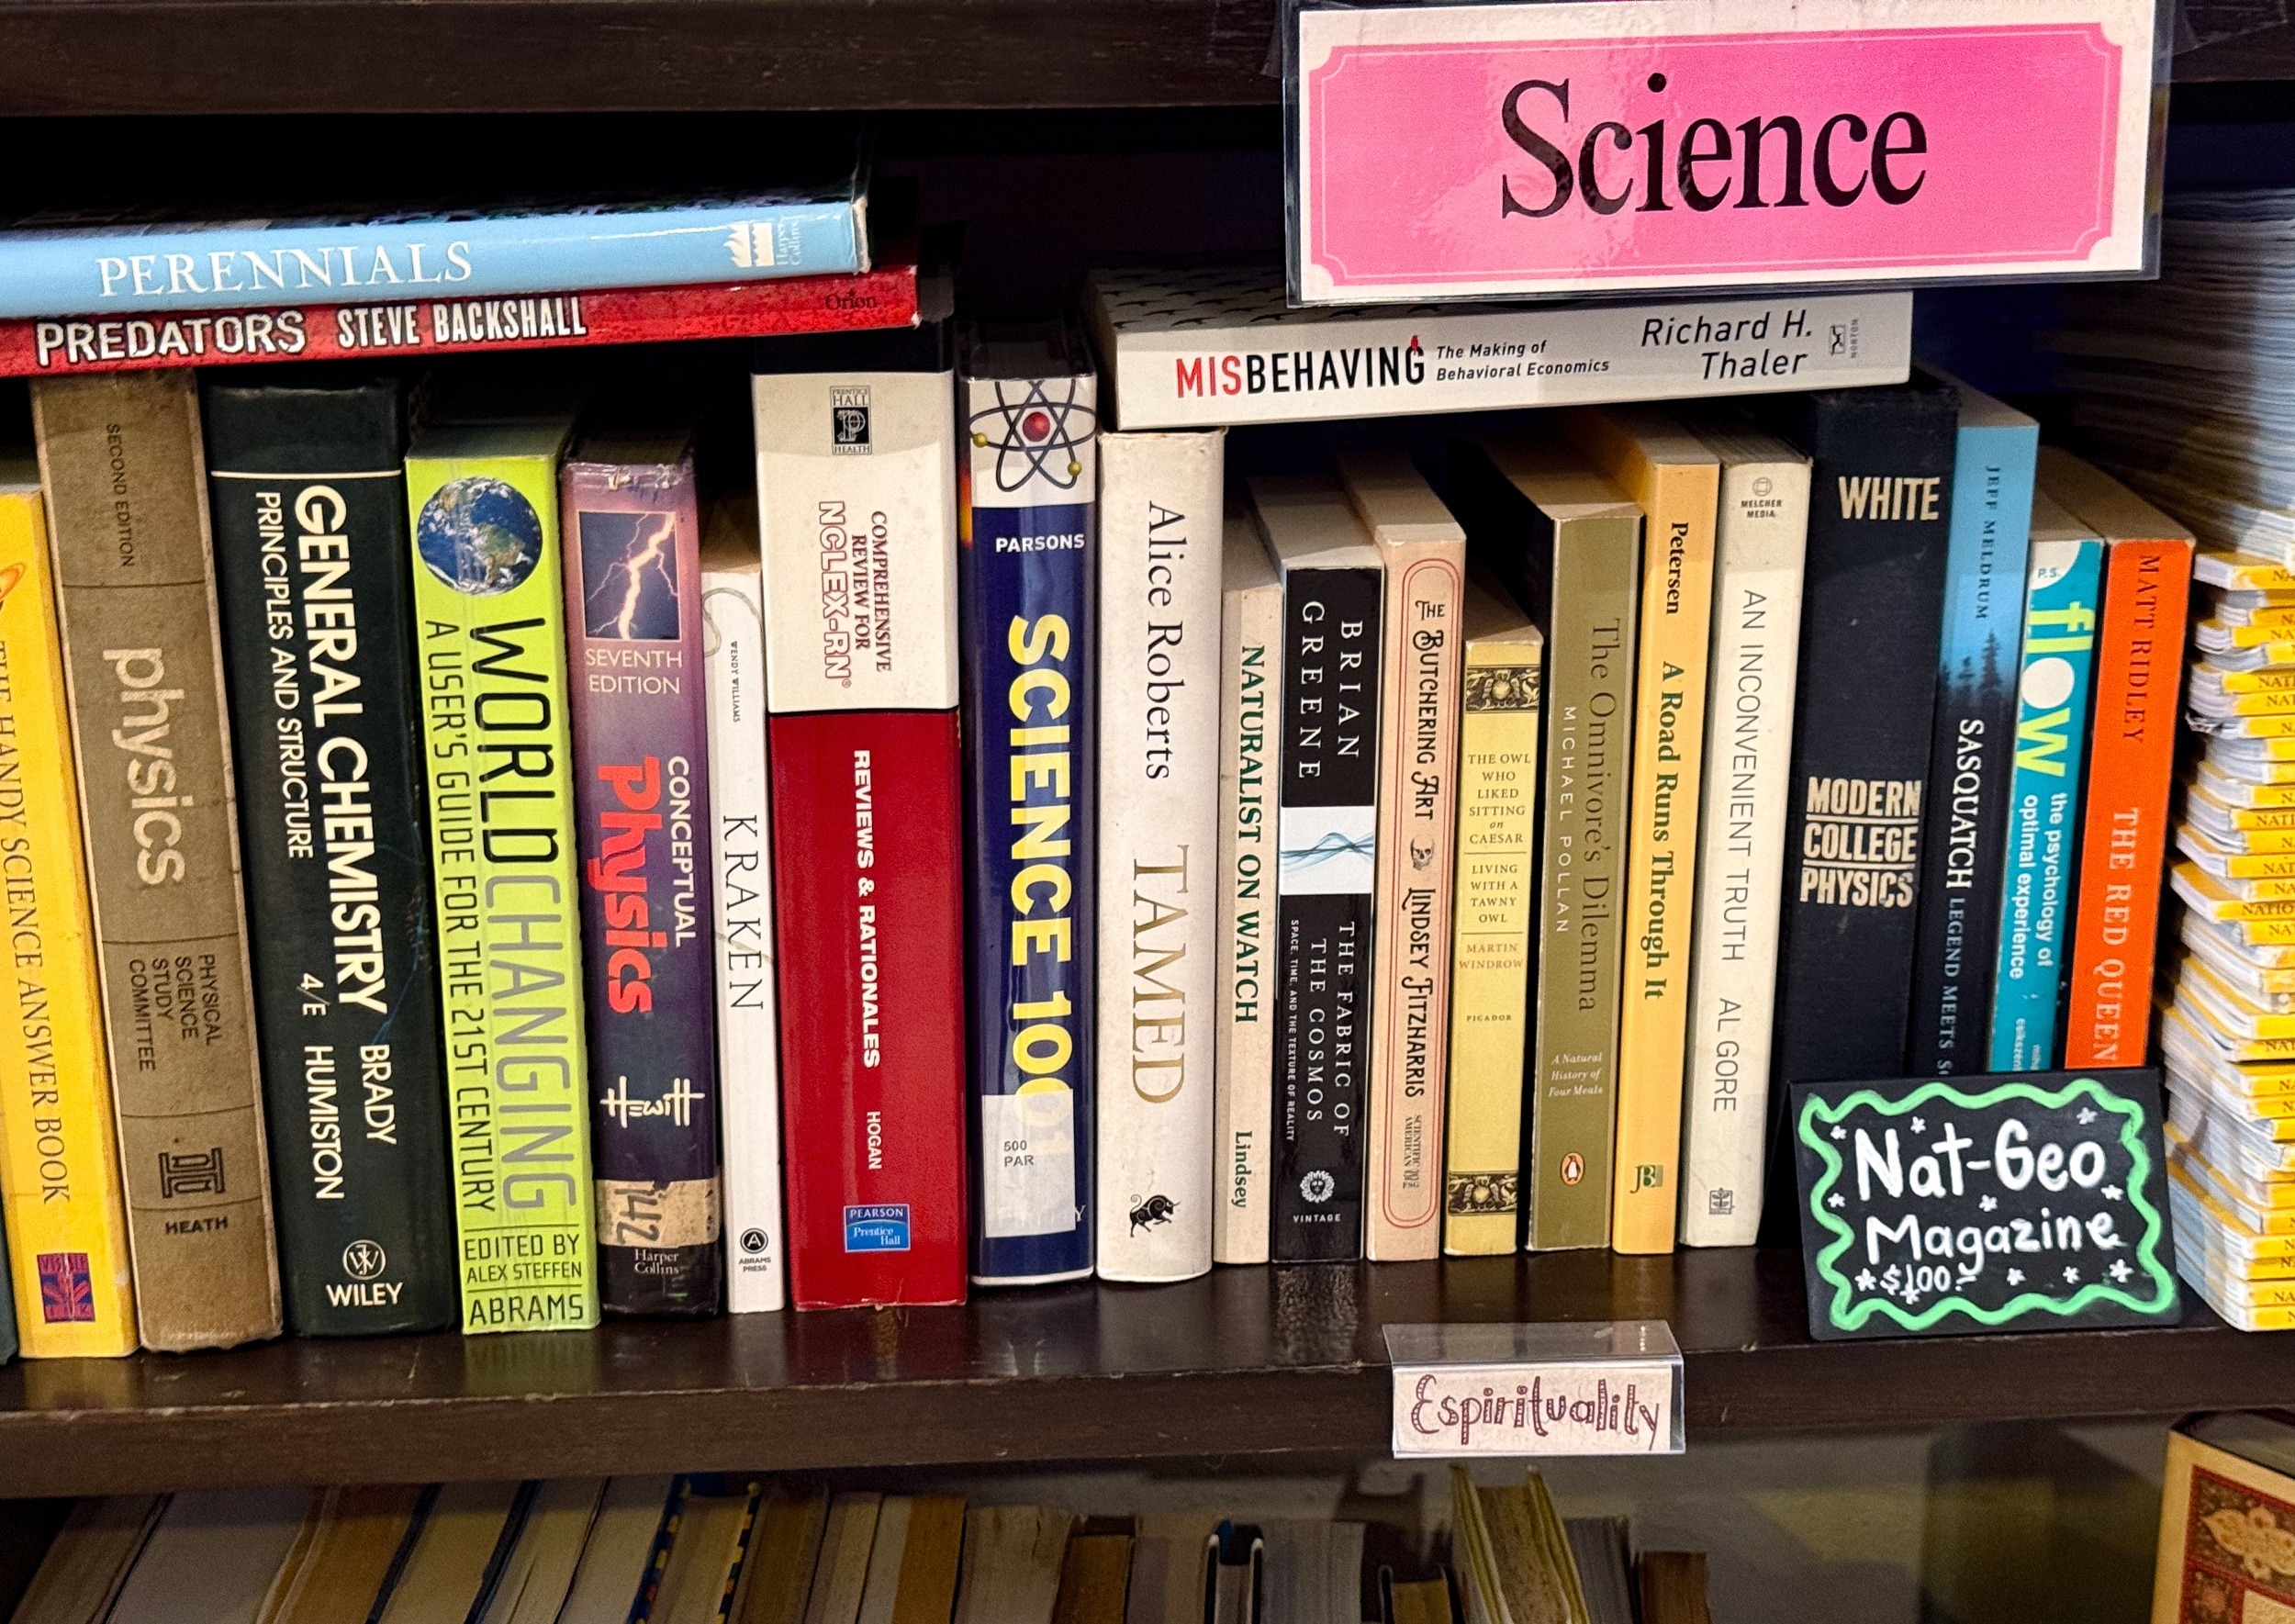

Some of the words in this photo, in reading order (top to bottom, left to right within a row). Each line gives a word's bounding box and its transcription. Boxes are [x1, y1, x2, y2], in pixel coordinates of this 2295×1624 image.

[1502, 72, 1927, 218] Science
[97, 240, 472, 298] PERENNIALS
[826, 289, 878, 310] Orion
[36, 309, 306, 366] PREDATORS
[337, 302, 420, 349] STEVE
[433, 296, 587, 343] BACKSHALL
[1437, 346, 1463, 359] The
[1470, 342, 1525, 358] Making
[1531, 340, 1547, 353] of
[1641, 311, 1770, 347] Richard
[1783, 309, 1812, 338] H.
[1176, 342, 1425, 398] MISBEHAVING
[1437, 364, 1521, 381] Behavioral
[1527, 359, 1609, 375] Economics
[1702, 349, 1808, 380] Thaler
[833, 395, 870, 407] HALL
[106, 423, 128, 496] SECOND
[834, 445, 870, 454] HEALTH
[1839, 476, 1940, 521] WHITE
[1986, 466, 2000, 510] JEFF
[116, 500, 135, 567] EDITION
[255, 492, 295, 639] PRINCIPLES
[995, 533, 1085, 554] PARSONS
[1148, 500, 1187, 607] Alice
[852, 534, 870, 610] REVIEW
[872, 510, 891, 672] COMPREHENSIVE
[1666, 522, 1689, 615] Petersen
[1976, 520, 1996, 619] MELDRUM
[2134, 554, 2160, 628] MATT
[295, 486, 364, 728] GENERAL
[425, 621, 460, 639] A
[855, 614, 870, 650] FOR
[1742, 589, 1766, 629] AN
[270, 646, 300, 711] AND
[586, 649, 682, 668] SEVENTH
[1590, 618, 1620, 679] The
[1662, 661, 1685, 682] A
[428, 652, 468, 757] USER'S
[589, 677, 680, 694] EDITION
[1146, 621, 1185, 779] Roberts
[1298, 600, 1325, 778] GREENE
[1338, 620, 1363, 757] BRIAN
[1413, 630, 1444, 765] BUTCHERING
[2122, 641, 2152, 743] RIDLEY
[1237, 645, 1265, 843] NATURALIST
[1658, 691, 1683, 763] Road
[1729, 644, 1763, 855] INCONVENIENT
[103, 646, 195, 885] physics
[277, 717, 313, 859] STRUCTURE
[1008, 614, 1071, 966] SCIENCE
[1468, 755, 1496, 765] THE
[1500, 754, 1531, 764] OWL
[1483, 771, 1516, 781] WHO
[1560, 706, 1576, 822] MICHAEL
[1583, 690, 1617, 862] Omnivore's
[437, 773, 475, 865] GUIDE
[854, 749, 875, 869] REVIEWS
[1411, 771, 1439, 820] ART
[1469, 806, 1525, 816] SITTING
[1477, 789, 1518, 799] LIKED
[1653, 772, 1678, 843] Runs
[1807, 776, 1921, 817] MODERN
[1946, 719, 1984, 890] SASQUATCH
[2050, 792, 2067, 824] the
[668, 756, 696, 947] CONCEPTUAL
[1470, 834, 1523, 844] CAESAR
[1804, 824, 1918, 863] COLLEGE
[2019, 794, 2040, 868] optimal
[2109, 808, 2139, 869] THE
[318, 737, 388, 1014] CHEMISTRY
[588, 756, 668, 1014] Physics
[858, 878, 875, 897] &
[1237, 855, 1260, 899] ON
[1471, 881, 1506, 890] WITH
[1472, 864, 1517, 874] LIVING
[1556, 835, 1572, 933] POLLAN
[1799, 867, 1914, 908] PHYSICS
[2035, 830, 2061, 941] psychology
[1, 837, 42, 968] SCIENCE
[442, 876, 478, 932] FOR
[470, 618, 577, 1209] WORLDCHANGING
[723, 814, 763, 1010] KRAKEN
[1402, 888, 1436, 969] LINDSEY
[1471, 897, 1517, 907] TAWNY
[1479, 913, 1507, 924] OWL
[1640, 851, 1674, 969] Through
[1722, 868, 1750, 960] TRUTH
[2010, 873, 2032, 980] experience
[2103, 884, 2132, 946] RED
[1236, 910, 1259, 1023] WATCH
[1310, 938, 1327, 993] THE
[1338, 922, 1355, 975] THE
[1459, 959, 1523, 969] WINDROW
[1466, 944, 1517, 953] MARTIN
[1579, 876, 1609, 1011] Dilemma
[1944, 897, 1965, 977] LEGEND
[2036, 947, 2054, 966] of
[151, 958, 174, 1021] STUDY
[174, 956, 199, 1040] SCIENCE
[198, 954, 222, 1046] PHYSICAL
[449, 946, 483, 997] THE
[858, 905, 880, 1070] RATIONALES
[1132, 845, 1190, 1104] TAMED
[1644, 979, 1667, 1000] It
[129, 959, 156, 1072] COMMITTEE
[452, 1008, 487, 1075] 21ST
[1335, 991, 1353, 1088] FABRIC
[1402, 977, 1433, 1098] FITZHARRIS
[1718, 998, 1741, 1032] AL
[1940, 985, 1957, 1049] MEETS
[2093, 958, 2125, 1062] QUEEN
[17, 980, 59, 1108] ANSWER
[1307, 1008, 1325, 1122] COSMOS
[1551, 1070, 1587, 1081] History
[1562, 1052, 1602, 1063] Natural
[1713, 1040, 1740, 1112] GORE
[360, 1044, 397, 1145] BRADY
[1334, 1103, 1349, 1137] OF
[1549, 1087, 1571, 1097] Four
[1573, 1084, 1603, 1095] Meals
[304, 1046, 344, 1200] HUMISTON
[457, 1089, 495, 1212] CENTURY
[867, 1111, 882, 1170] HOGAN
[1003, 1140, 1027, 1151] 500
[34, 1118, 71, 1204] BOOK
[1003, 1155, 1035, 1167] PAR
[1231, 1131, 1252, 1209] Lindsey
[1854, 1118, 2105, 1201] Nat-Geo
[165, 1216, 228, 1236] HEATH
[850, 1208, 903, 1218] PEARSON
[1293, 1214, 1341, 1224] VINTAGE
[1865, 1208, 2127, 1276] Magazine
[465, 1235, 543, 1260] EDITED
[554, 1234, 579, 1255] BY
[467, 1265, 507, 1282] ALEX
[514, 1262, 582, 1281] STEFFEN
[634, 1249, 679, 1262] Harper
[634, 1261, 679, 1275] Collins
[326, 1282, 404, 1307] WILEY
[469, 1294, 584, 1325] ABRAMS
[1411, 1374, 1659, 1450] Espirituality
